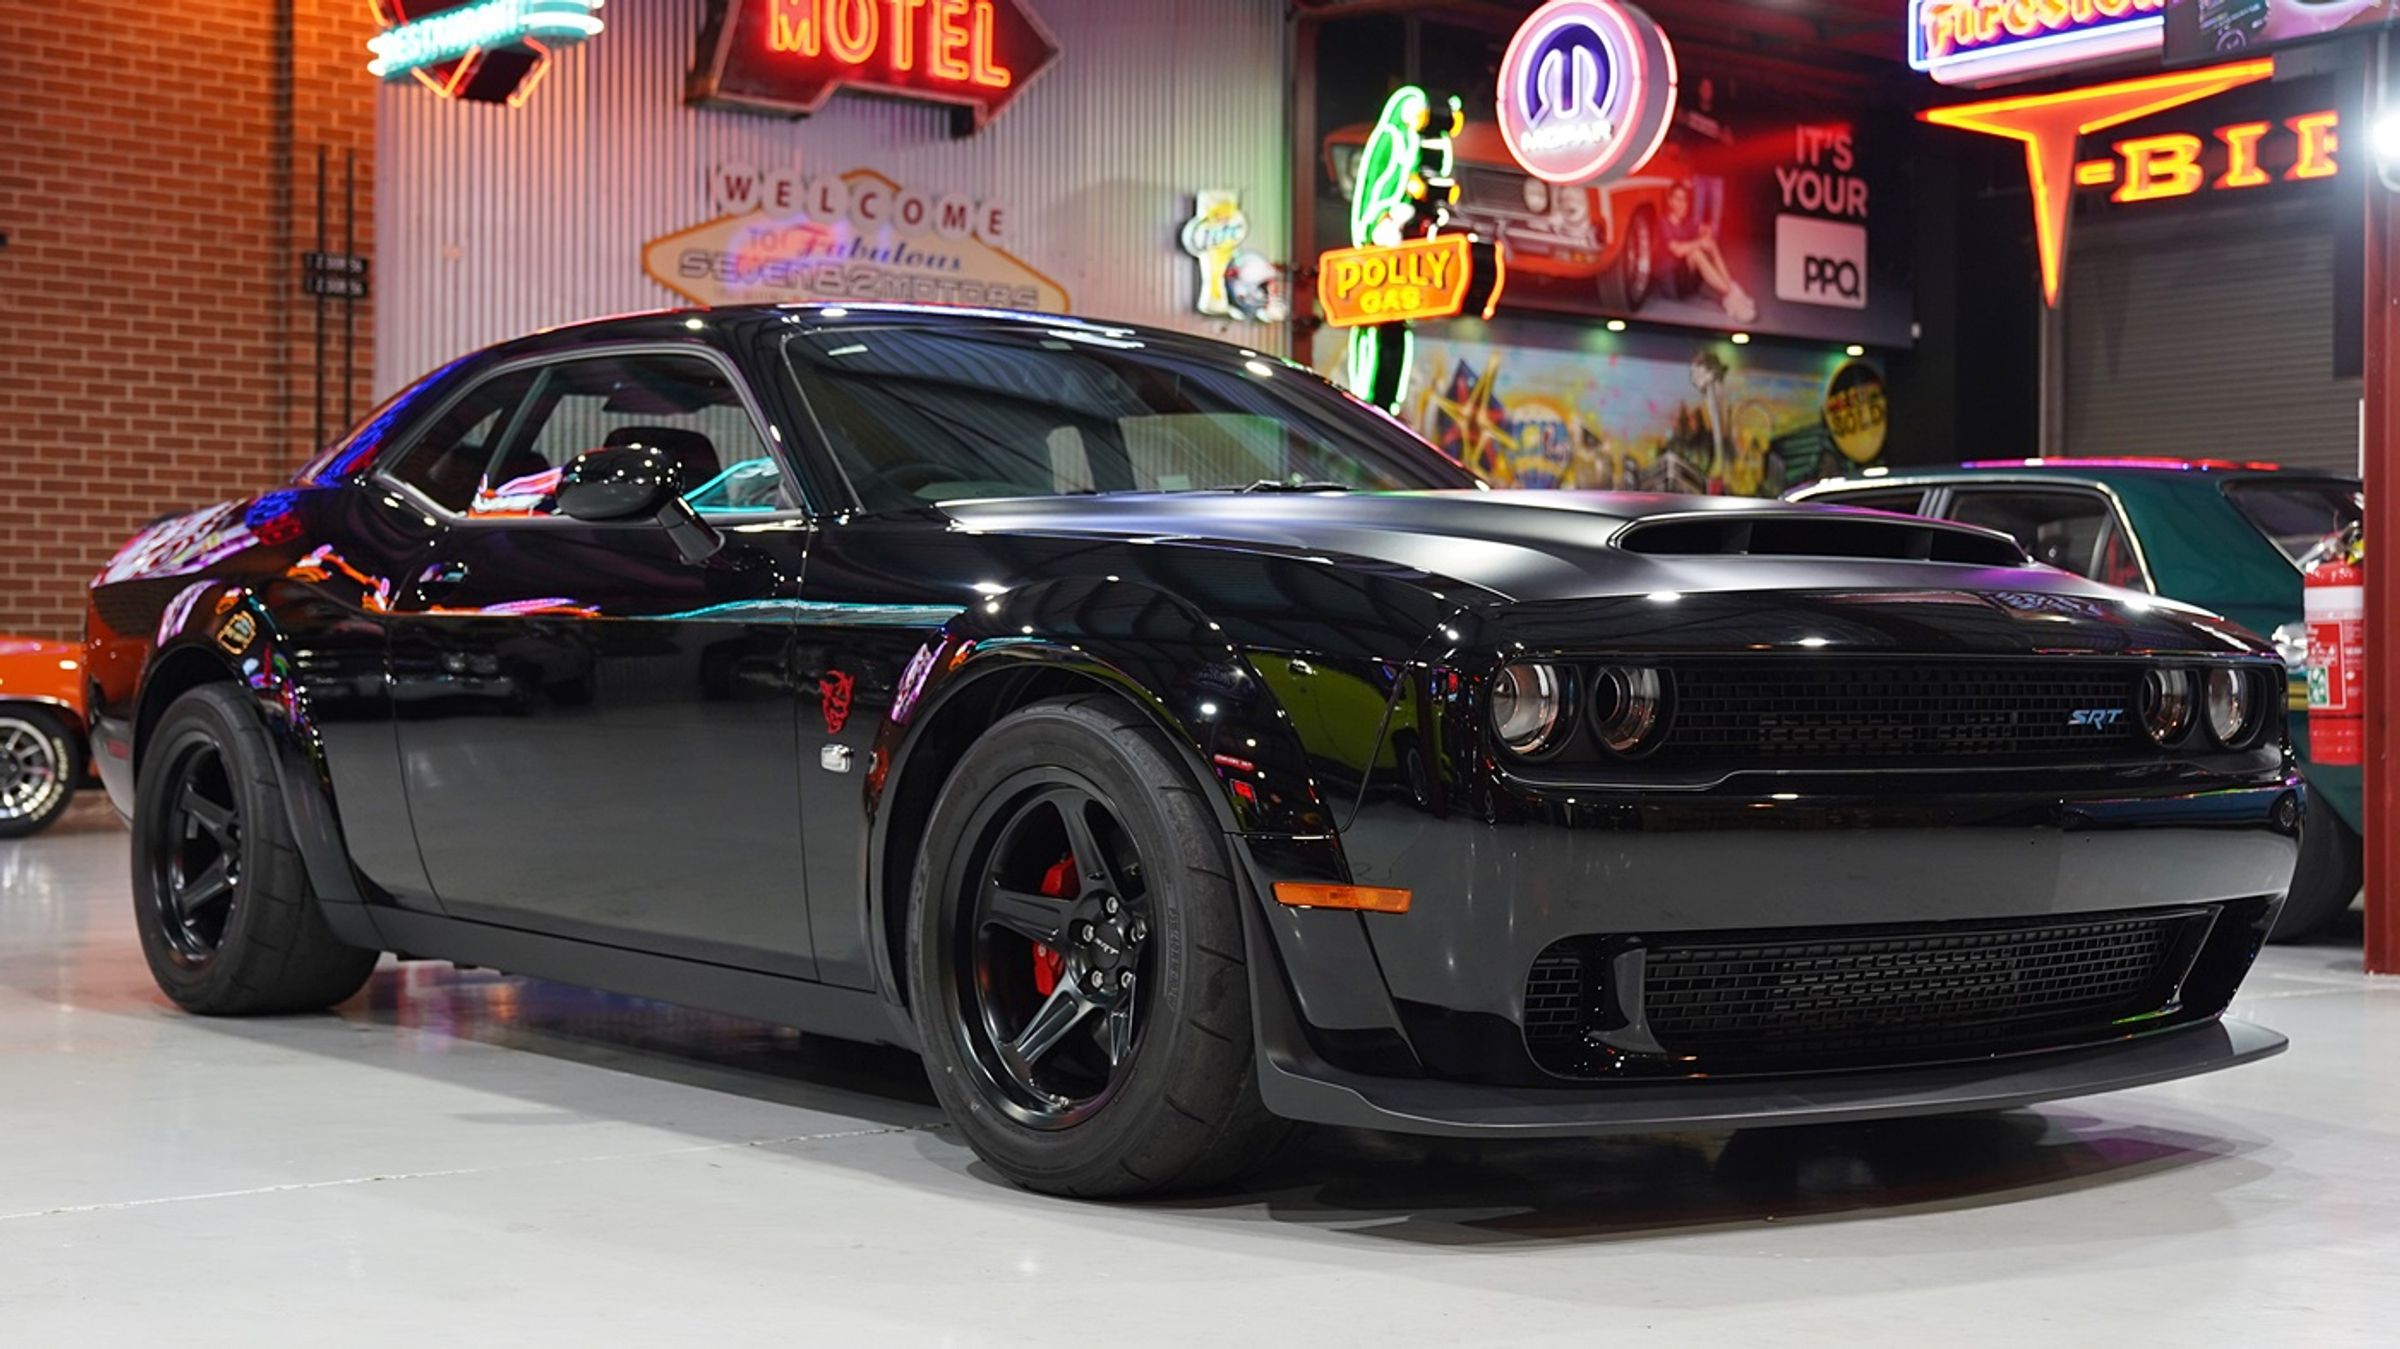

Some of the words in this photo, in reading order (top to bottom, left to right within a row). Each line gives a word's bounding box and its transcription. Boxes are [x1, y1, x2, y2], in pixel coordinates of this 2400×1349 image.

[767, 0, 1012, 88] MOTEL
[1796, 123, 1854, 172] IT'S
[724, 174, 1004, 236] WELCOME
[1775, 165, 1869, 218] YOUR
[784, 222, 963, 272] Fabulous
[1335, 249, 1450, 299] POLLY
[1804, 255, 1860, 299] PPQ
[1360, 285, 1421, 314] GAS
[2067, 708, 2124, 730] SRT
